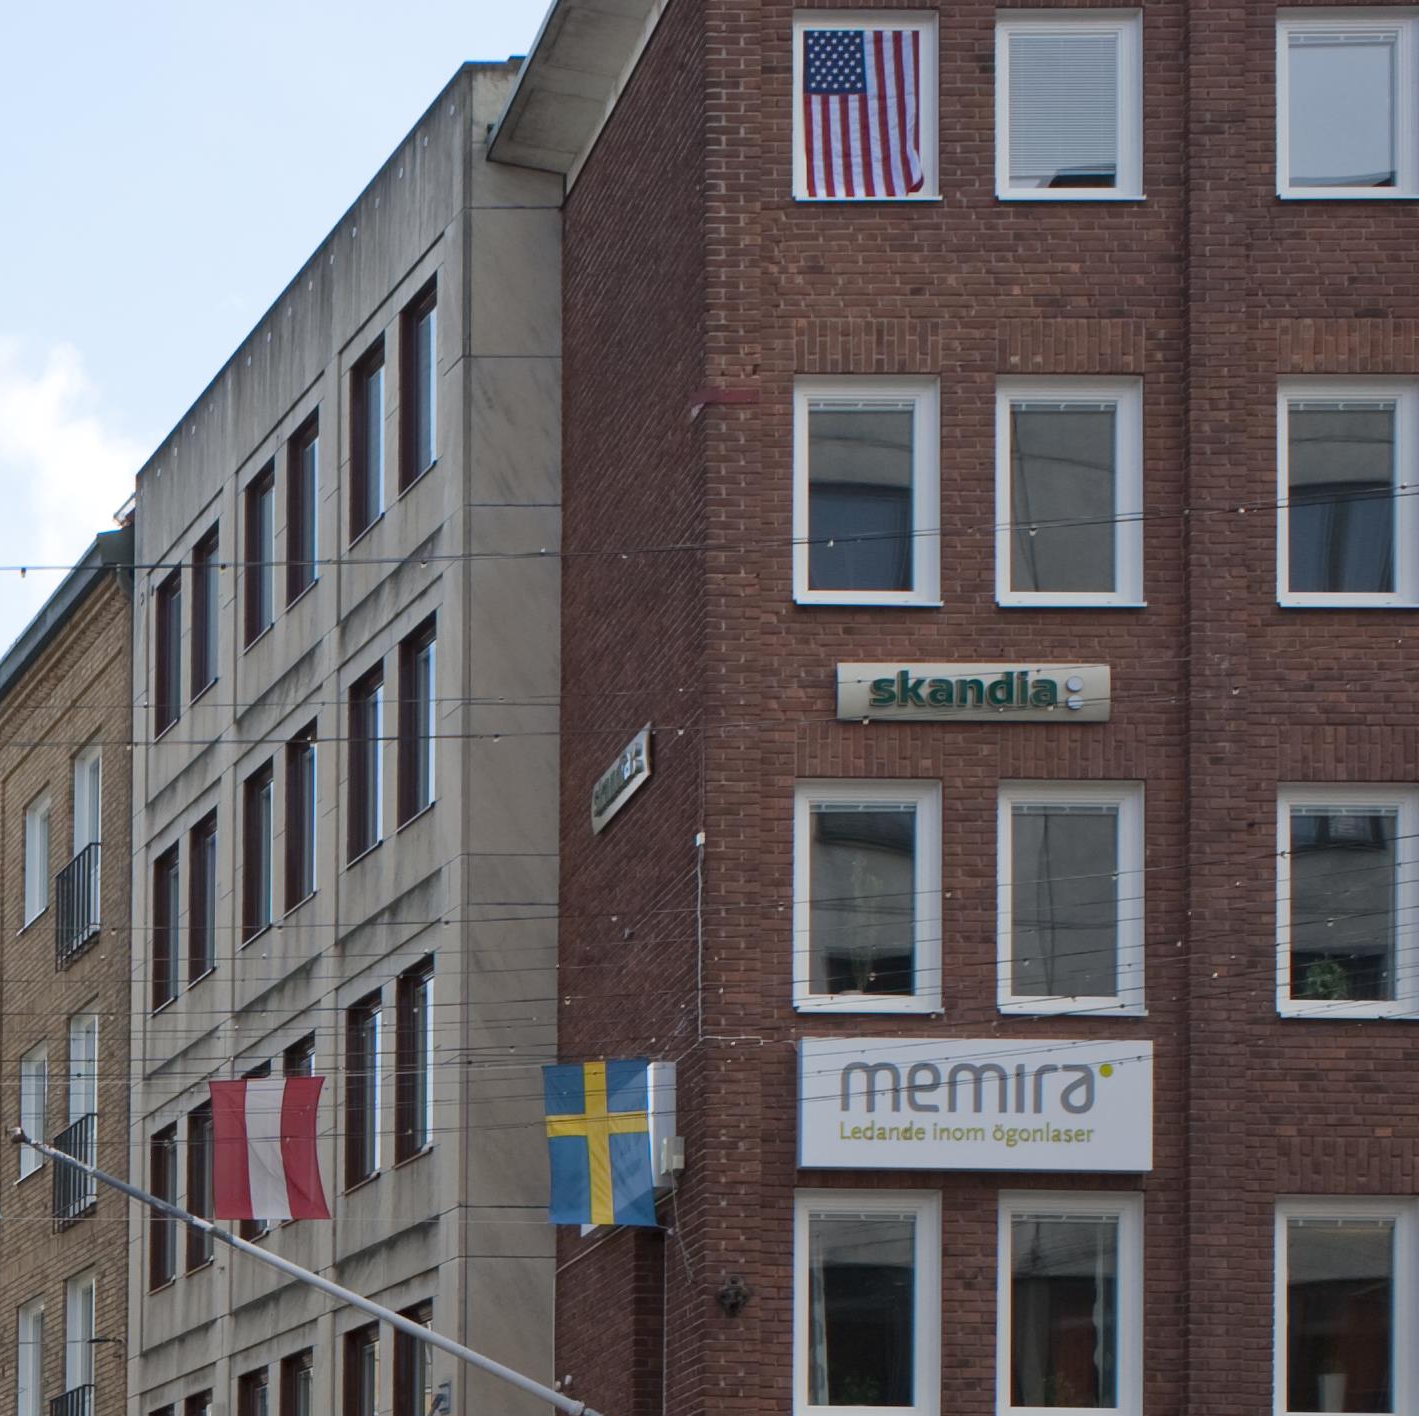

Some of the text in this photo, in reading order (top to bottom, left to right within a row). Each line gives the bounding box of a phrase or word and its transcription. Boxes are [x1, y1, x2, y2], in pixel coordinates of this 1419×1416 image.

[870, 670, 1059, 707] skandia
[840, 1061, 1095, 1114] memira
[840, 1120, 1094, 1147] Ledande inom ögonlaser
